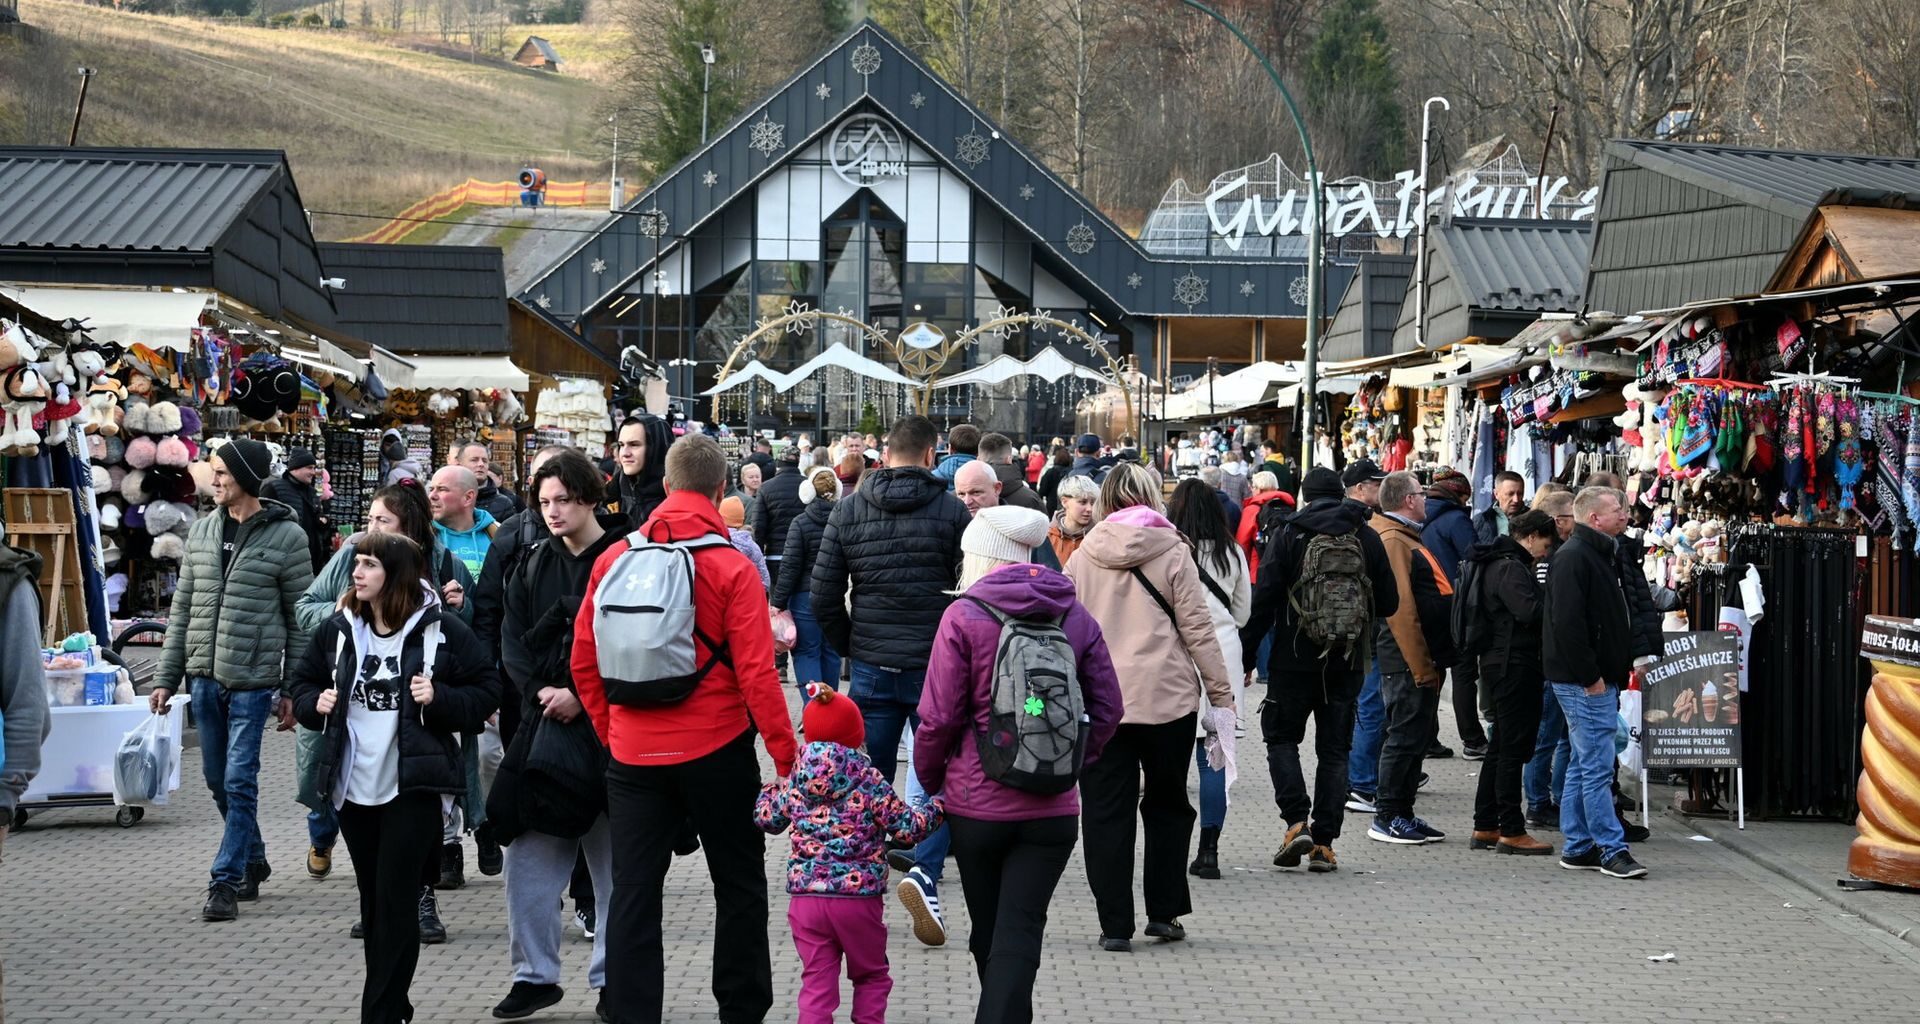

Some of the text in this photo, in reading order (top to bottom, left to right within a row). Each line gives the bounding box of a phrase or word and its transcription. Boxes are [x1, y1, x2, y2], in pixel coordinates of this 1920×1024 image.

[1645, 650, 1734, 686] RZEMIEŚLNICZE
[1648, 728, 1657, 736] TU
[1658, 728, 1676, 736] ZJESZ
[1677, 727, 1699, 736] ŚWIEŻE
[1653, 747, 1731, 755] OD PODSTAW NA MIEJSCU
